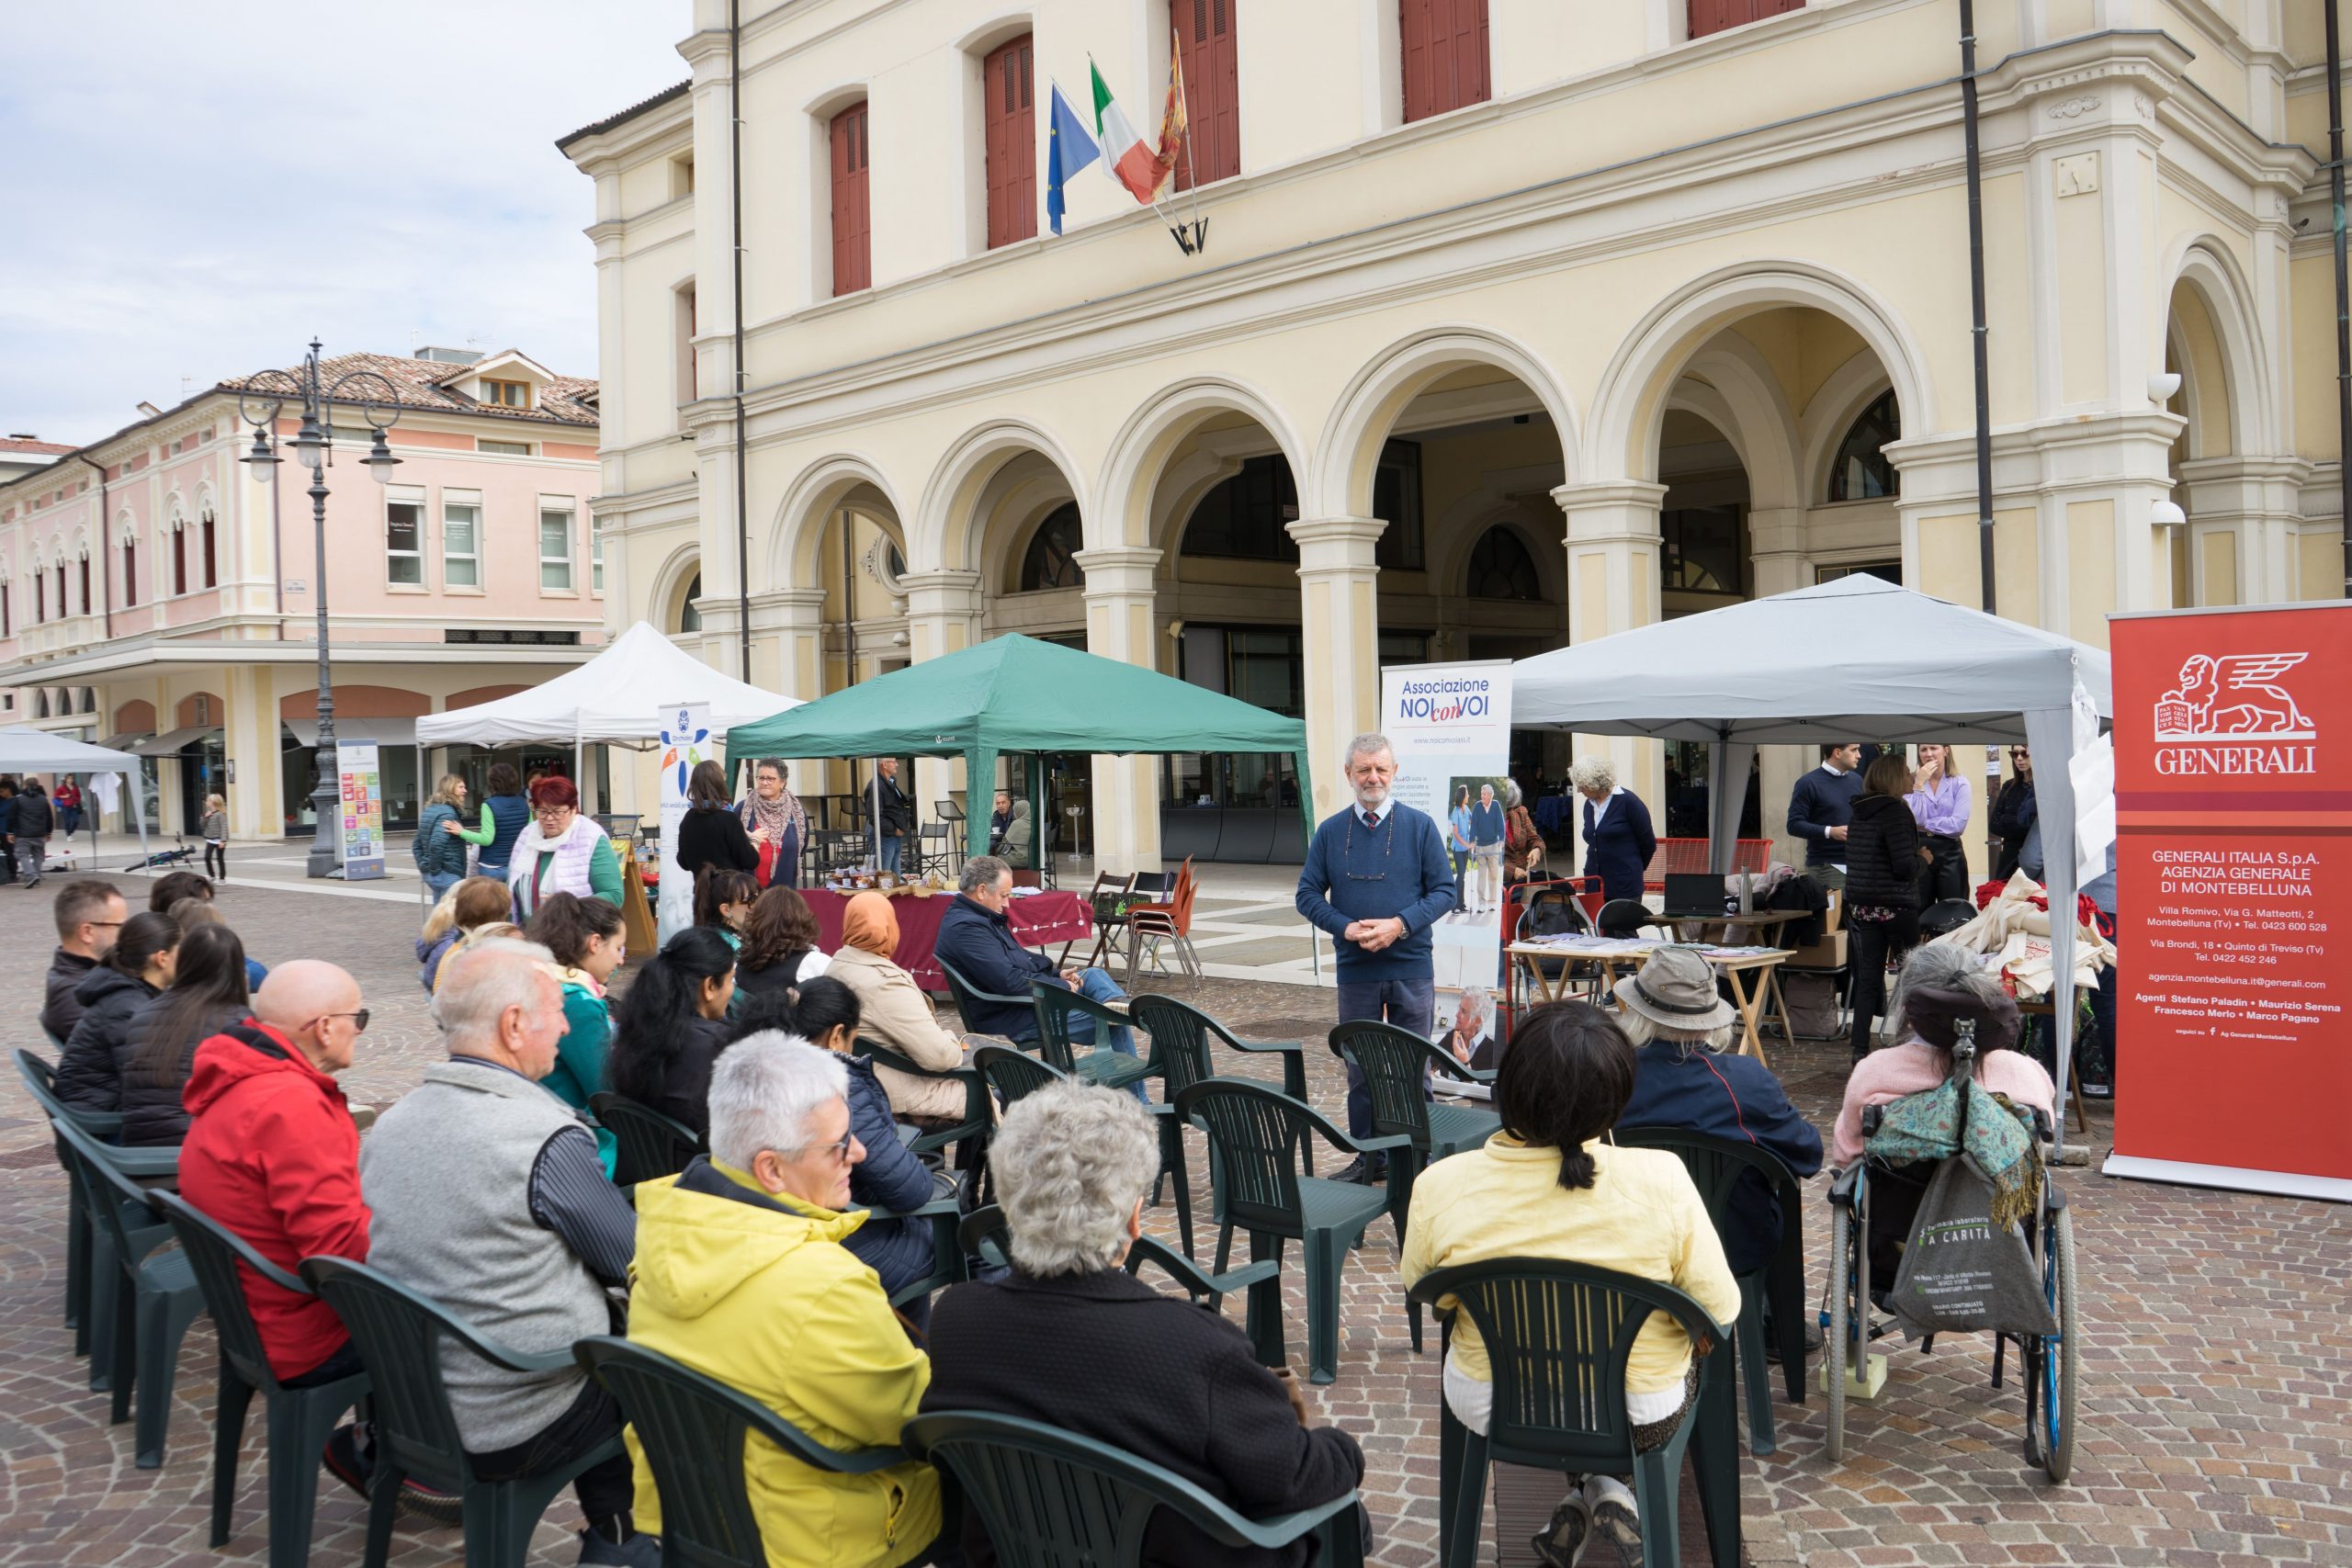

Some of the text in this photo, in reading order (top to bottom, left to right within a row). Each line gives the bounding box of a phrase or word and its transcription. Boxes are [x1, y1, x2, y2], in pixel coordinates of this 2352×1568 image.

[1402, 678, 1489, 695] Associazione
[1401, 696, 1488, 722] NOI con VOI
[2155, 746, 2316, 775] GENERALI
[2153, 851, 2319, 866] GENERALI ITALIA S.p.A.
[2162, 867, 2311, 880] AGENZIA GENERALE
[2161, 882, 2312, 896] DI MONTEBELLUNA
[2159, 907, 2179, 915] Villa
[2182, 908, 2220, 917] Romivo,
[2257, 910, 2304, 919] Matteotti,
[2148, 918, 2211, 927] Montebelluna
[2214, 920, 2231, 930] (Tv)
[2243, 921, 2259, 929] Tel.
[2262, 922, 2285, 930] 0423
[2168, 940, 2199, 950] Brondi,
[2224, 942, 2255, 952] Quinto
[2258, 944, 2267, 952] di
[2270, 944, 2303, 954] Treviso
[2306, 945, 2323, 955] (Tv)
[2213, 954, 2235, 962] 0422
[2148, 973, 2325, 989] agenzia.montebelluna.it@generali.com
[2136, 993, 2341, 1012] Agenti Stefano Paladin Maurizio Serena
[2155, 1006, 2204, 1016] Francesco
[2247, 1012, 2278, 1020] Marco
[2281, 1014, 2319, 1024] Pagano
[1943, 1225, 1991, 1242] CARITÀ
